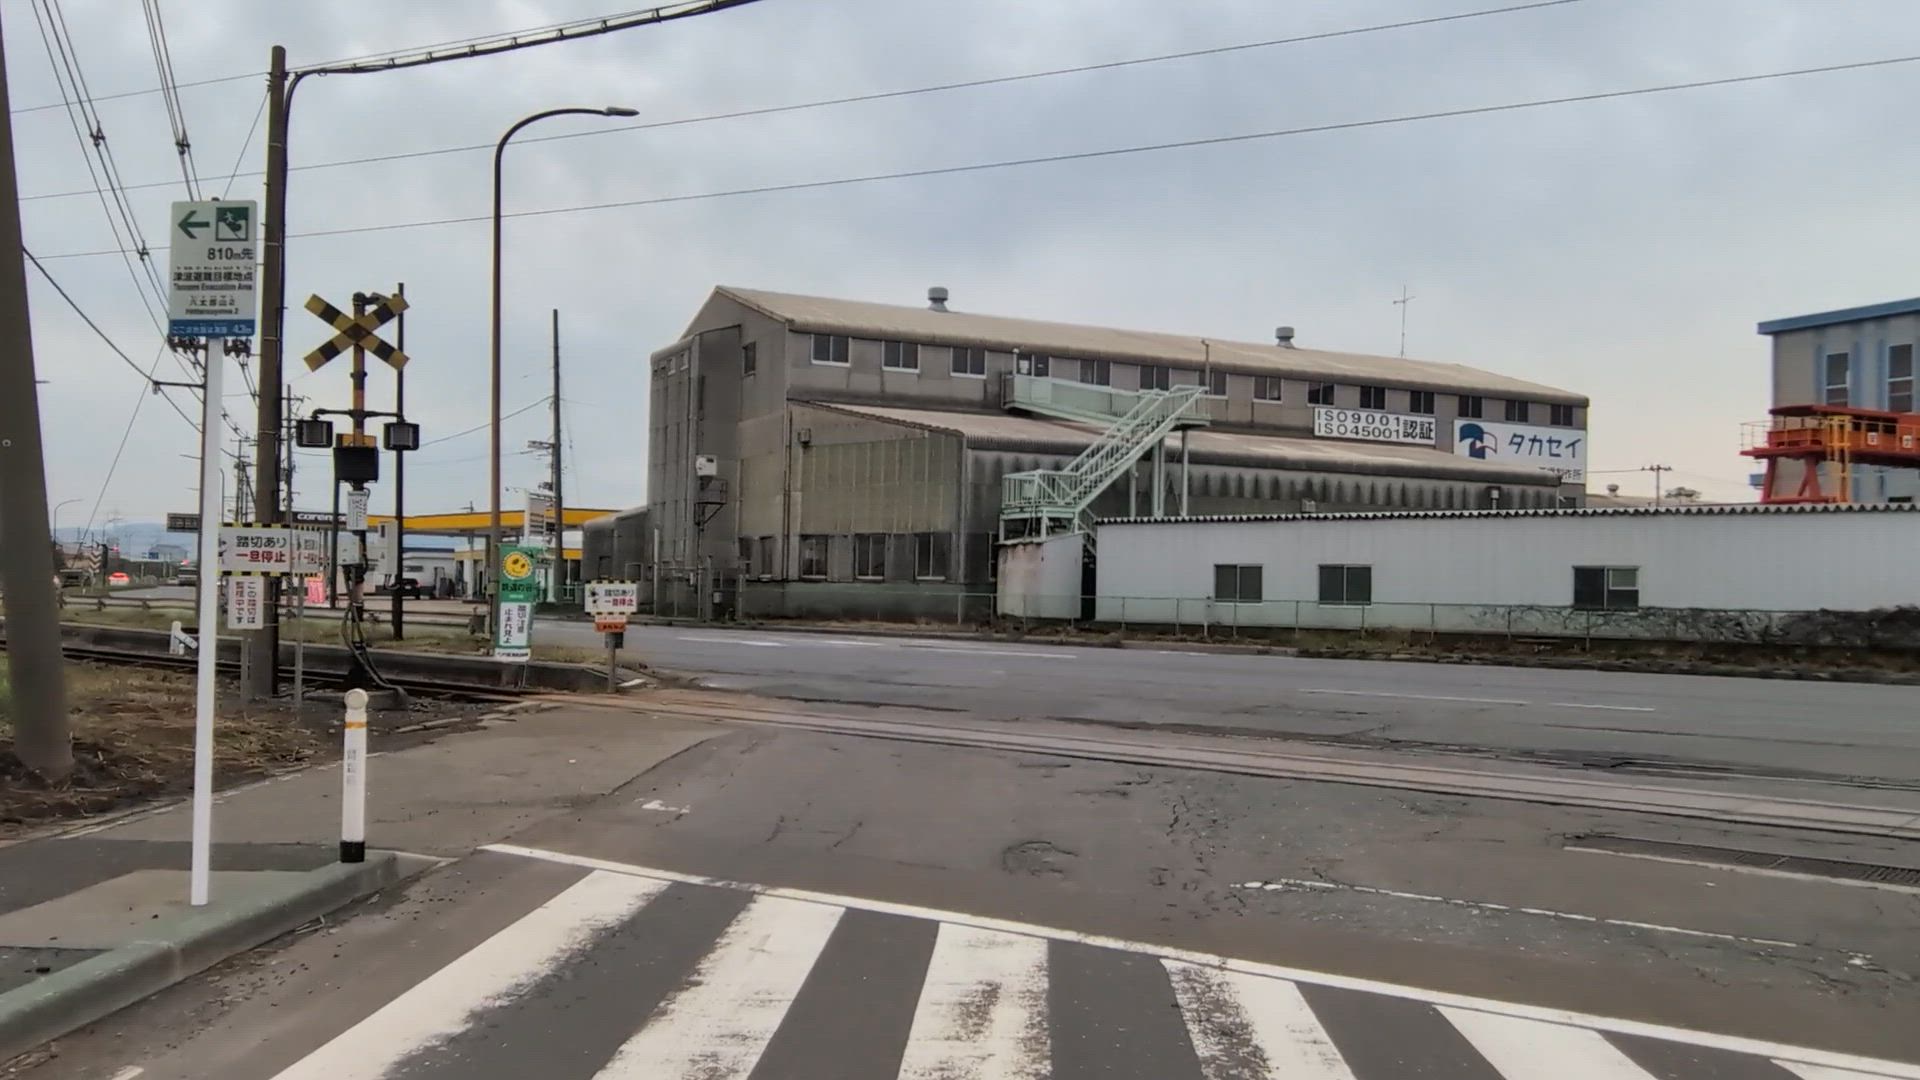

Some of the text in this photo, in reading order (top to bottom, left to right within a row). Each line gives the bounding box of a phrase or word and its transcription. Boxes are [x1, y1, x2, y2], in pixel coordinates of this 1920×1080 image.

[1317, 409, 1401, 427] ISO9001
[1317, 422, 1401, 439] ISO45001
[1402, 419, 1434, 440] 認証
[1508, 432, 1582, 459] タカセイ
[236, 535, 287, 548] 踏切あり
[235, 550, 286, 563] 一旦停止
